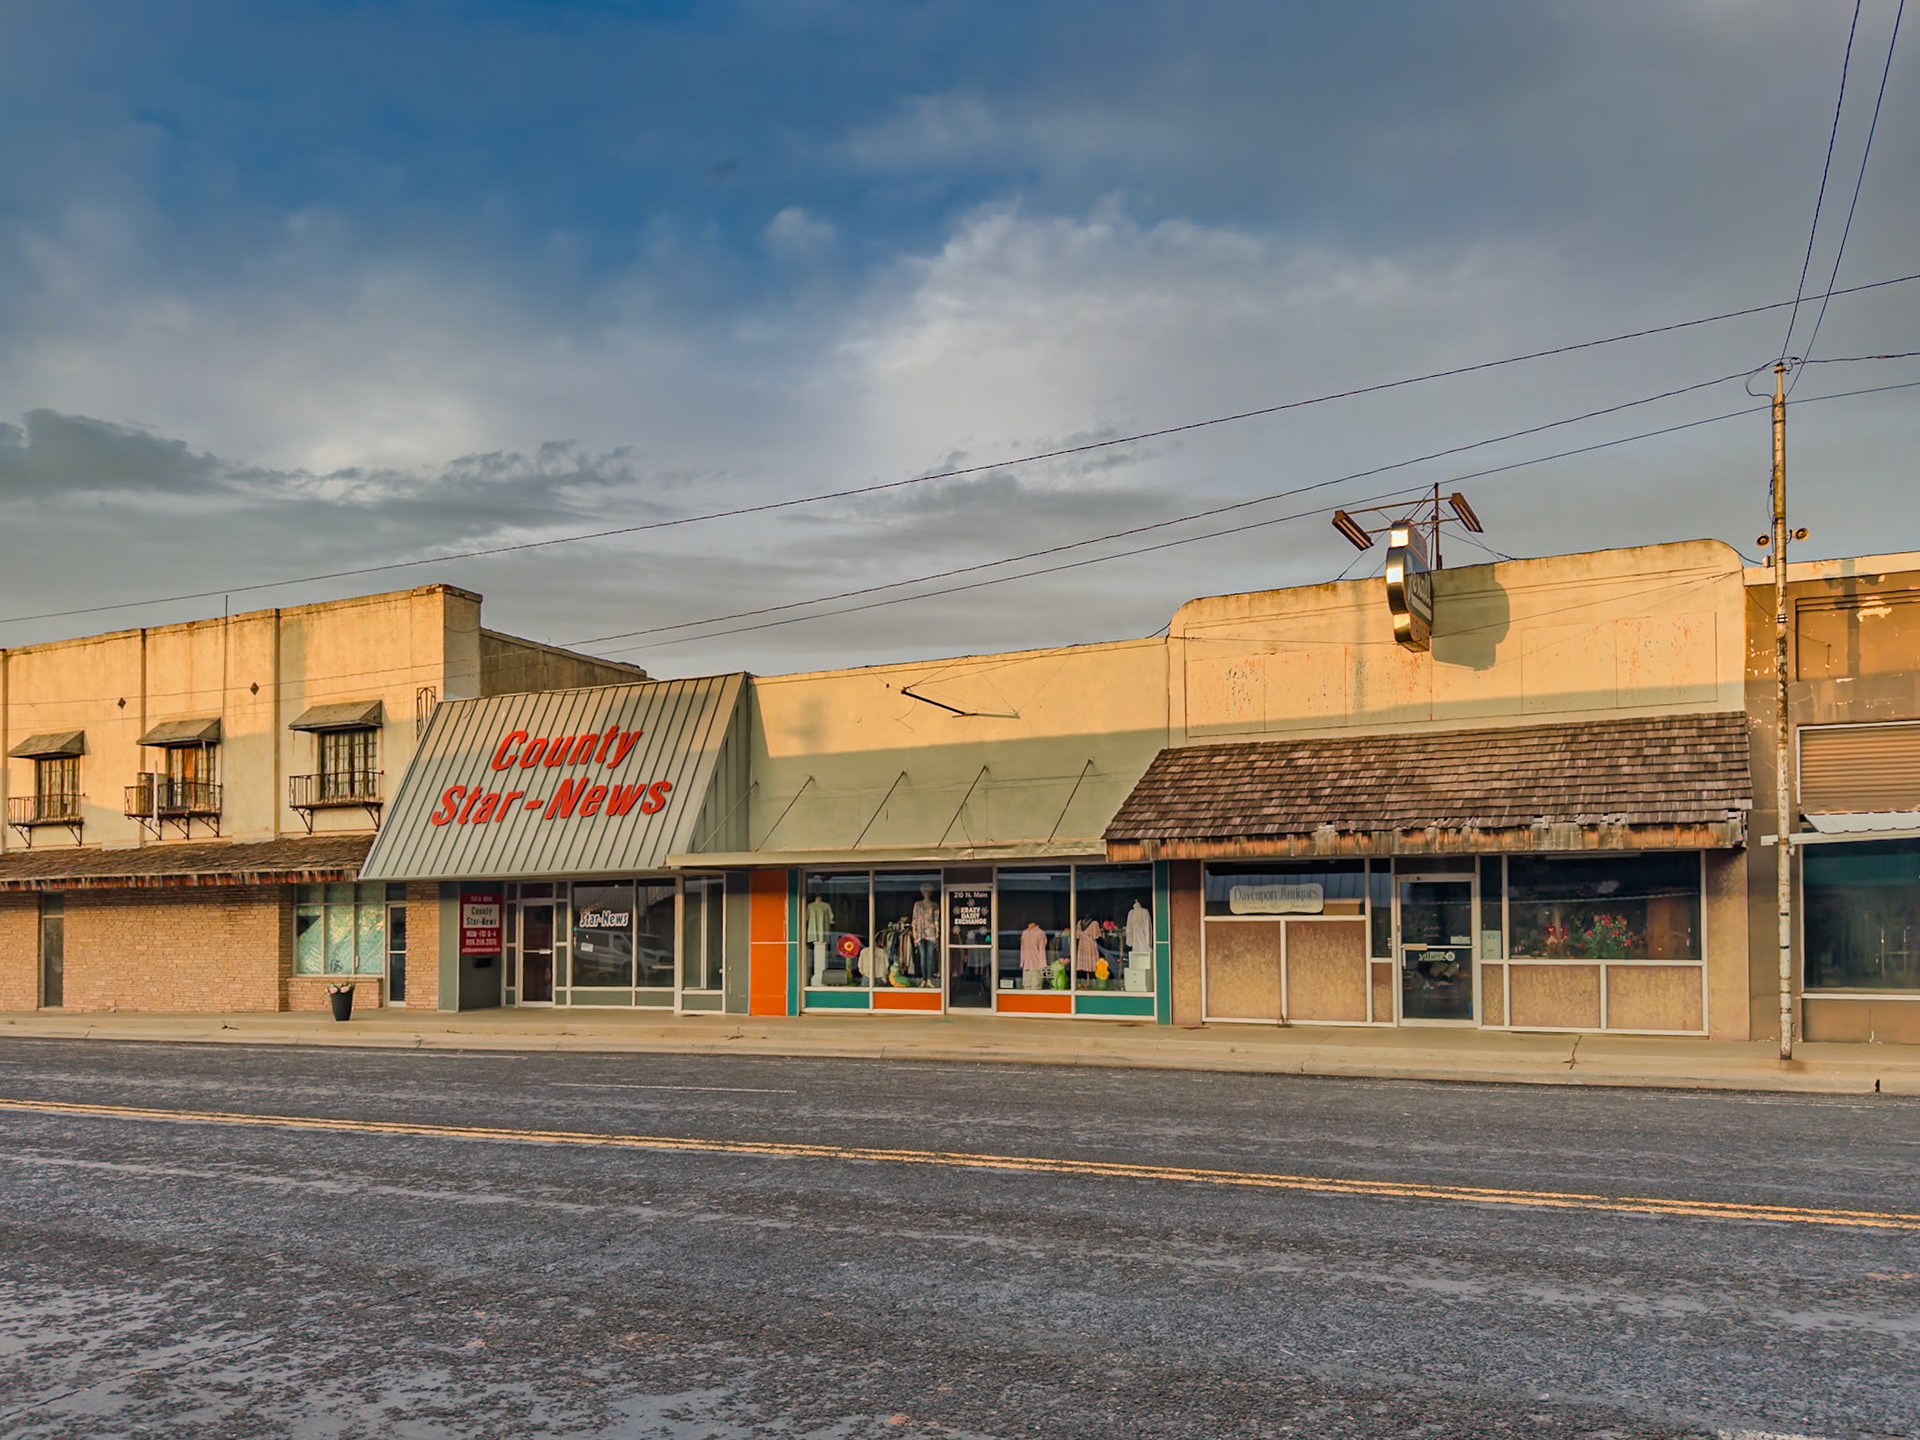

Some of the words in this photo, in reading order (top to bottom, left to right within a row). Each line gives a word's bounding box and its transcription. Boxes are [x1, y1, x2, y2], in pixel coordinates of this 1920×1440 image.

[490, 724, 643, 771] County
[430, 776, 672, 826] Star-News
[1234, 887, 1278, 902] Davenport
[1280, 886, 1319, 901] Antiques
[471, 906, 493, 917] County
[579, 910, 630, 928] Star-News
[466, 916, 498, 926] Star-News
